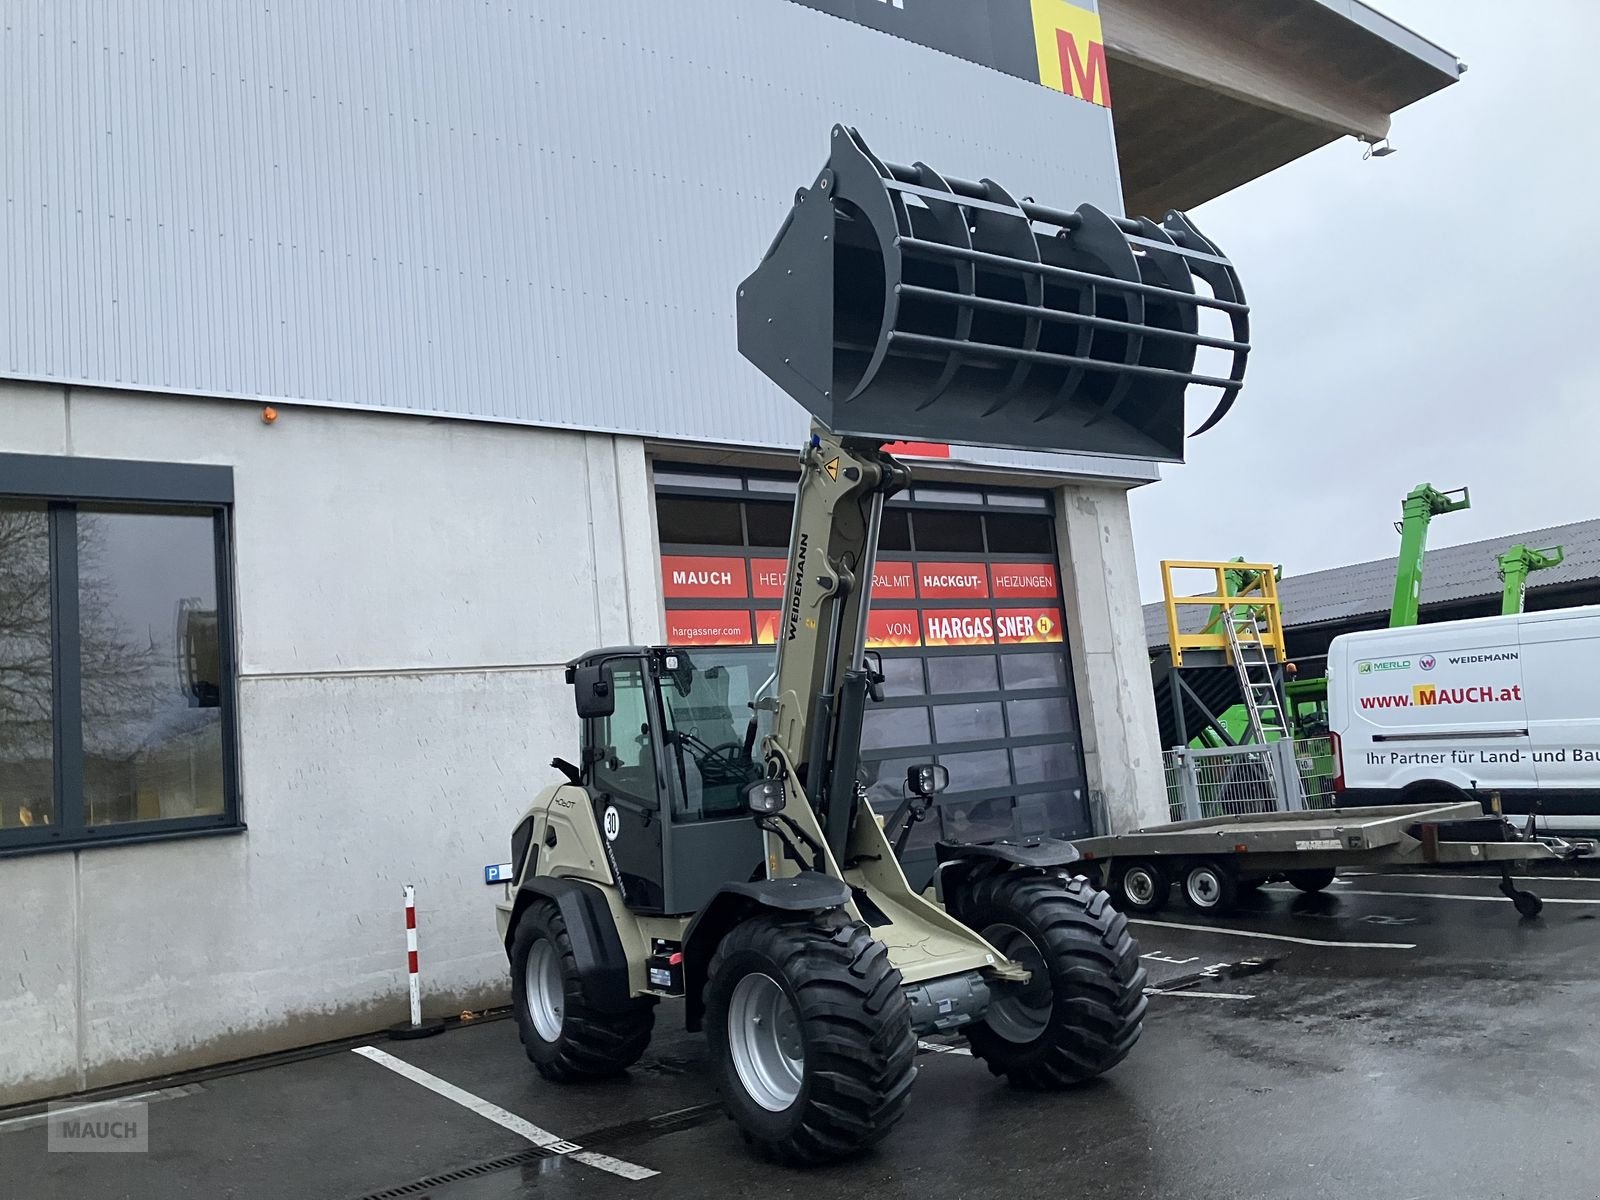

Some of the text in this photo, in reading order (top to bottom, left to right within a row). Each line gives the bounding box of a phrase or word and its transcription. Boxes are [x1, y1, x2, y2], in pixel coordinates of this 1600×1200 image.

[1056, 28, 1111, 108] M
[672, 571, 731, 585] MAUCH
[893, 575, 910, 587] MIT
[924, 575, 982, 588] HACKGUT-
[996, 575, 1052, 588] HEIZUNGEN
[788, 533, 808, 641] WEIDEMANN
[672, 626, 741, 638] hargassner.com
[886, 623, 912, 635] VON
[1374, 660, 1411, 670] MERLO
[1448, 652, 1519, 664] WEIDEMANN
[1366, 752, 1386, 765] Ihr
[1390, 751, 1446, 764] Partner
[1451, 750, 1475, 764] für
[1480, 749, 1526, 763] Land-
[1532, 748, 1566, 762] und
[607, 812, 616, 834] 30
[489, 868, 498, 880] P
